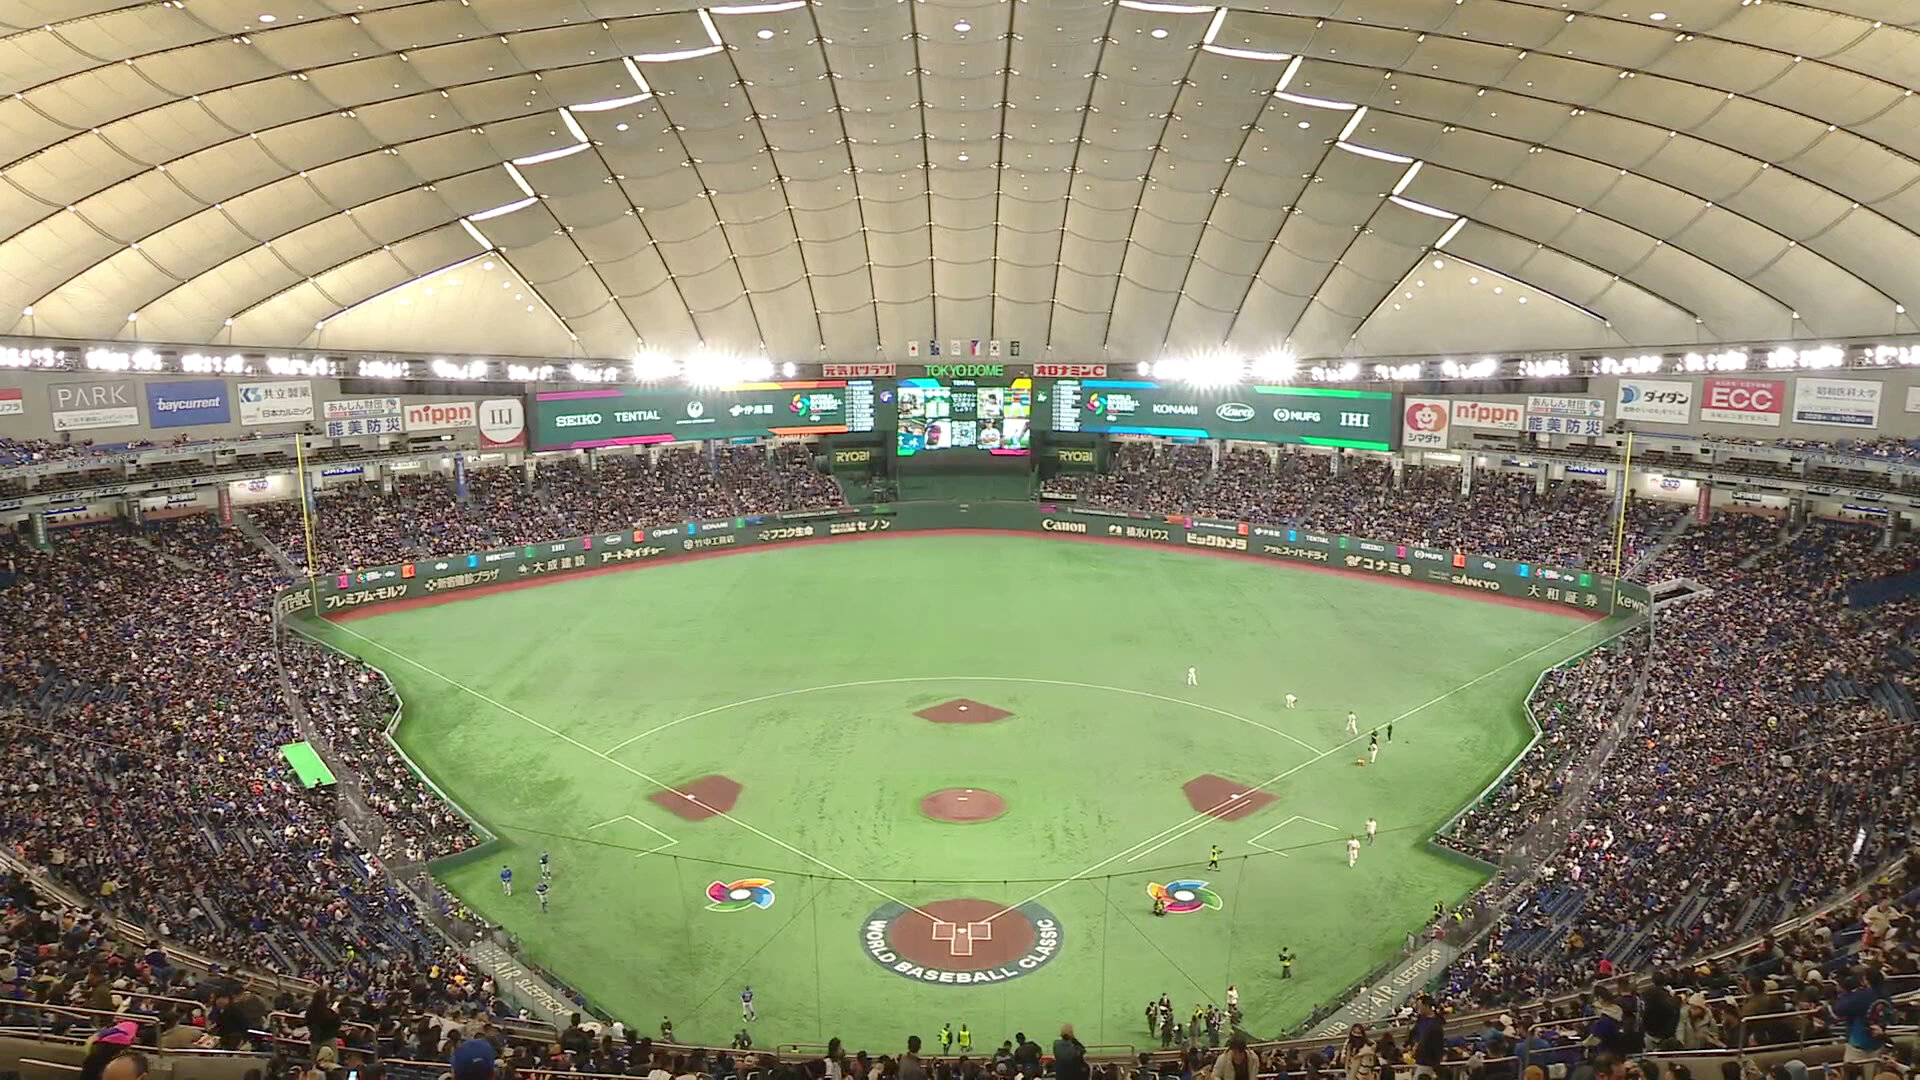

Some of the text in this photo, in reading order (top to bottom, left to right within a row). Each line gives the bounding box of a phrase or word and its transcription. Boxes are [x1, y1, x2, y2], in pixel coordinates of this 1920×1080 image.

[825, 364, 895, 376] 元気ハツラツ!
[924, 365, 1004, 376] TOKYO DOME
[1036, 365, 1105, 376] オロナミンC
[57, 385, 128, 408] PARK
[1644, 390, 1689, 405] ダイダン
[1711, 387, 1774, 410] ECC
[157, 397, 221, 412] baycurrent
[1153, 404, 1198, 415] KONAMI
[410, 406, 472, 425] nippn
[490, 408, 512, 425] IIJ
[556, 413, 602, 427] SEIKO
[614, 410, 660, 422] TENTIAL
[1290, 410, 1321, 422] MUFG
[1340, 412, 1370, 427] IHI
[1456, 403, 1519, 423] nippn
[328, 419, 401, 437] 能美防災
[1528, 417, 1600, 435] 能美防災
[1408, 433, 1441, 443] シマダヤ
[836, 451, 870, 462] RYOBI
[1059, 451, 1092, 462] RYOBI
[702, 522, 728, 531] KONAMI
[770, 526, 814, 539] フコク生命
[858, 520, 890, 531] セノン
[1042, 519, 1087, 533] Canon
[1126, 526, 1170, 540] 積水ハウス
[1187, 532, 1248, 550] ビックカメラ
[601, 547, 666, 562] アートネイチャー
[533, 554, 586, 574] 大成建設
[1451, 574, 1500, 590] SANKYO
[1528, 584, 1598, 608] 大和証券
[866, 918, 1057, 984] WORLD BASEBALL CLASSIC
[1371, 949, 1442, 1008] AIR SLEEPTECH
[494, 961, 569, 1016] AIR SLEEPTECH
